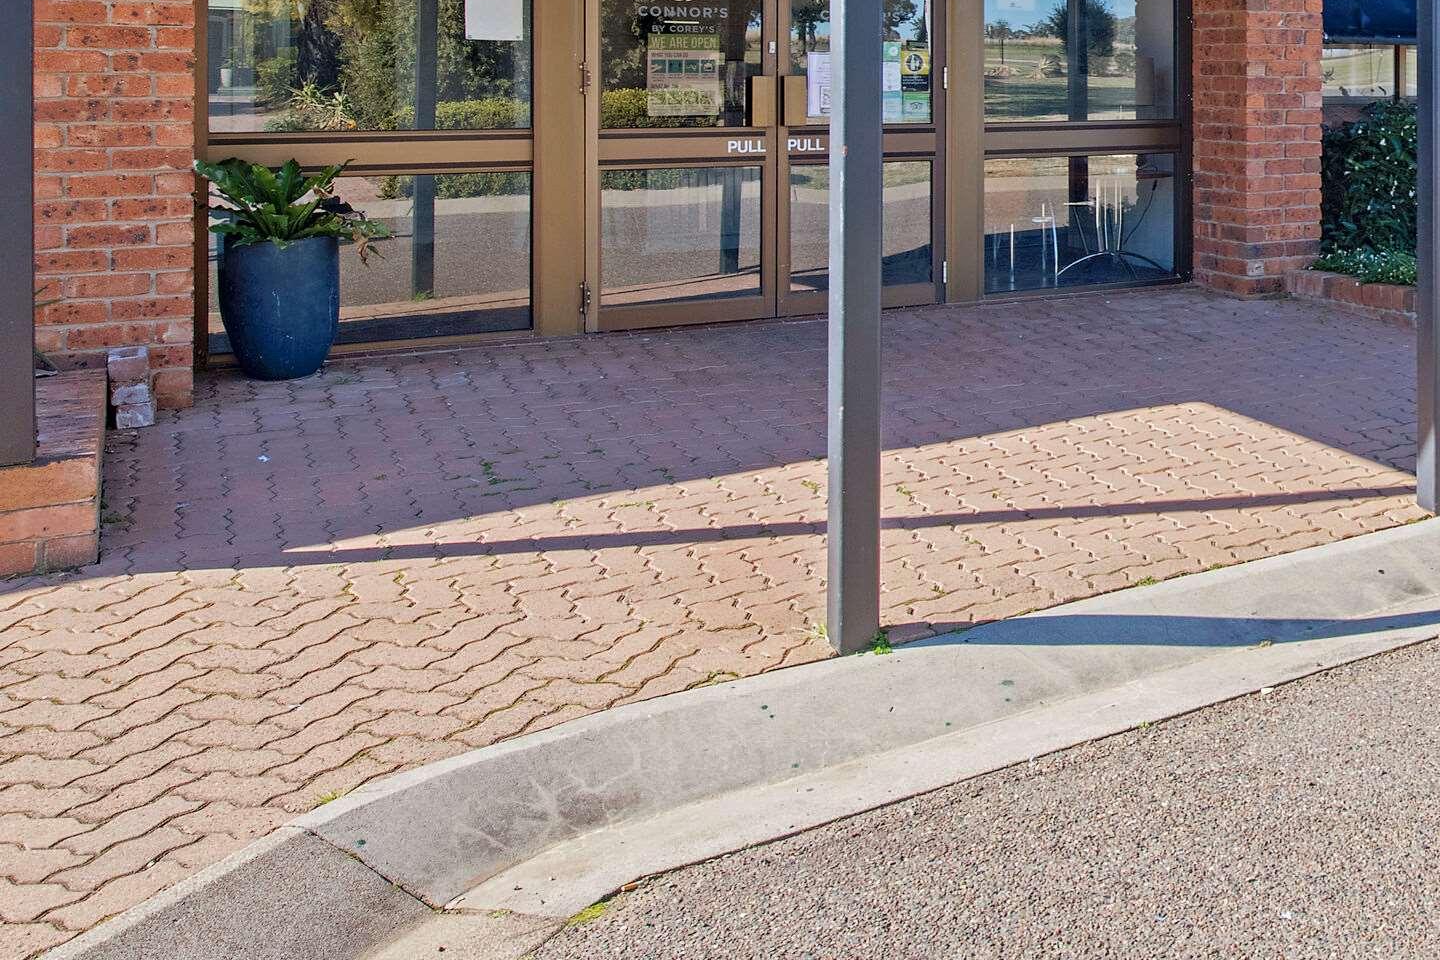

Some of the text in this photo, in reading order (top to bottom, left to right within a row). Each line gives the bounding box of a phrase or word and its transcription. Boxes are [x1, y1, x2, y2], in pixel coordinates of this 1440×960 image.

[639, 5, 729, 19] CONNOR'S
[651, 24, 716, 34] BY COREY'S
[669, 36, 690, 49] ARE
[691, 36, 717, 50] OPEN
[727, 140, 767, 154] PULL
[787, 138, 825, 151] PULL
